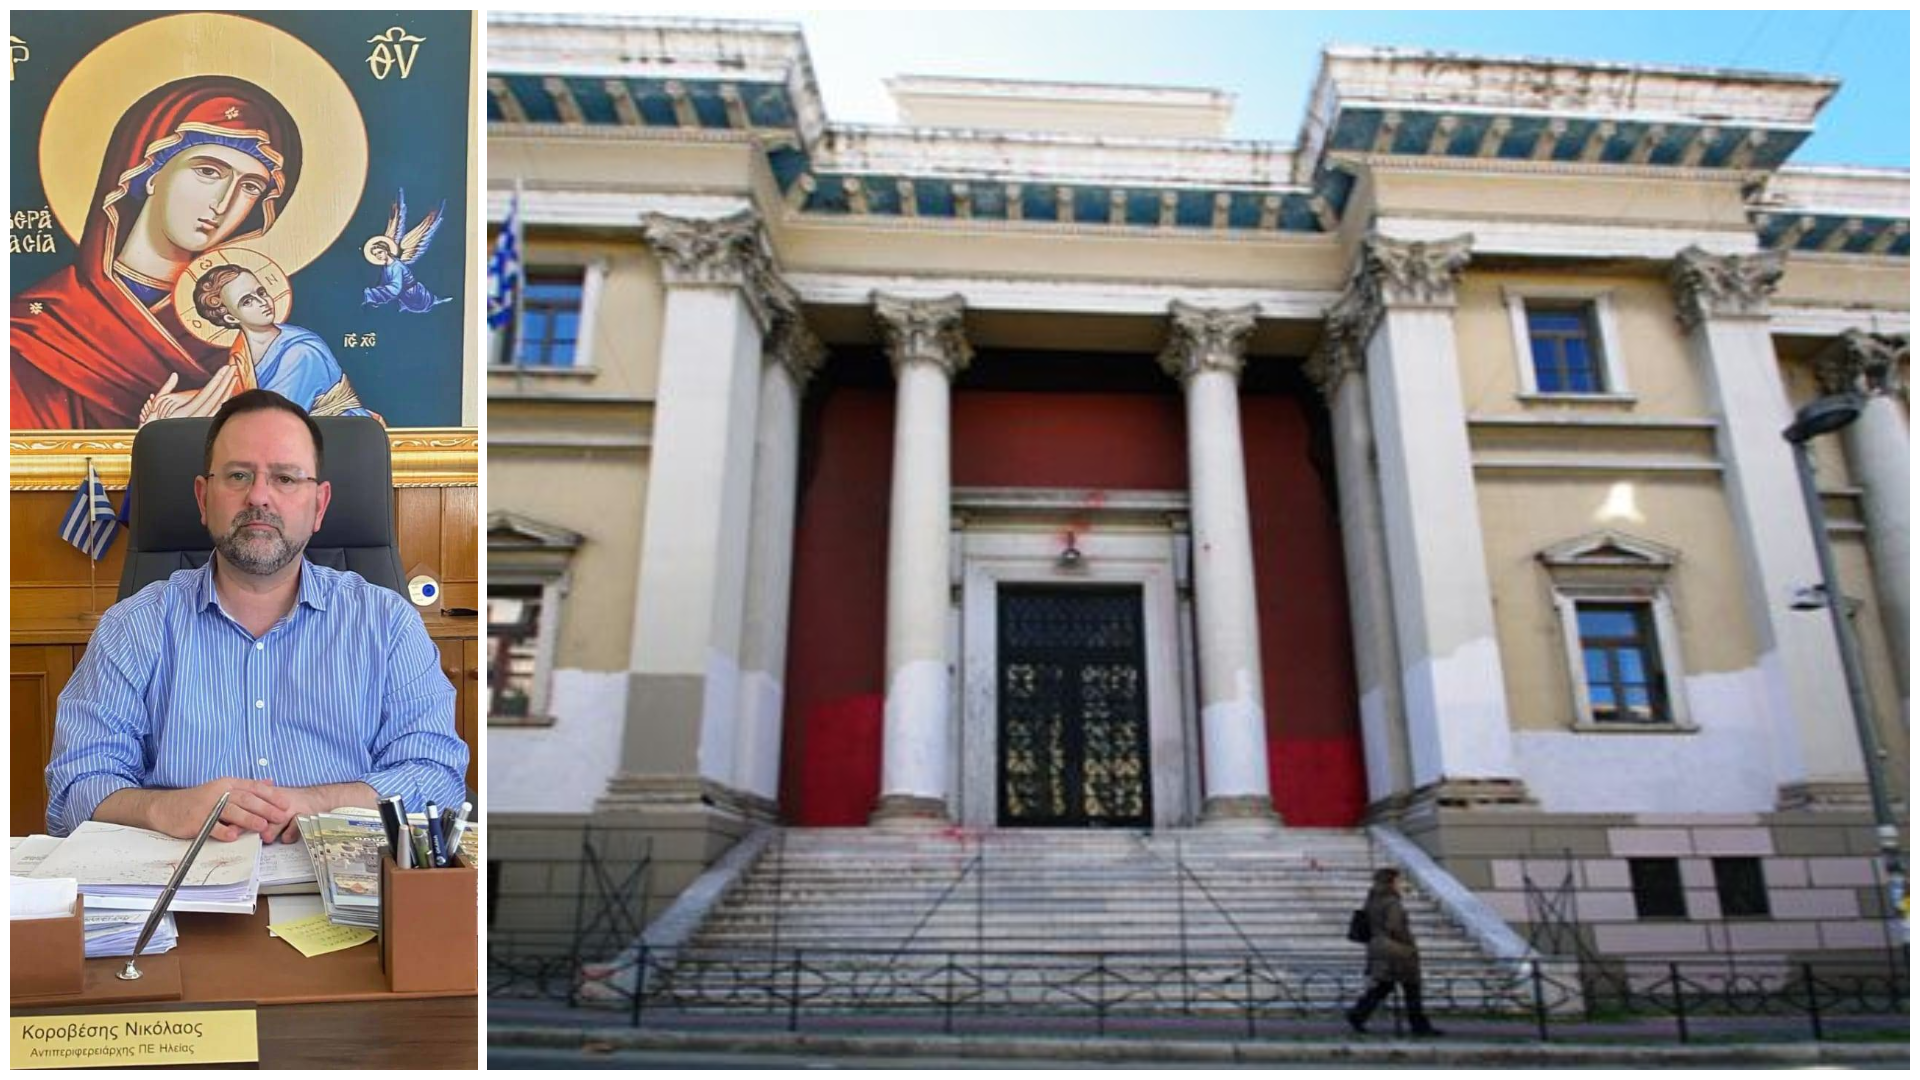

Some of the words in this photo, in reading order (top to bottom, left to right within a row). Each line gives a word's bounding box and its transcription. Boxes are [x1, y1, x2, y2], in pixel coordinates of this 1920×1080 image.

[22, 1023, 119, 1042] Κοροβέσης
[125, 1020, 203, 1037] Νικόλαος
[30, 1045, 135, 1059] Αντιπεριφερειάρχης
[138, 1043, 155, 1054] ΠΕ
[159, 1042, 195, 1055] Ηλείας
